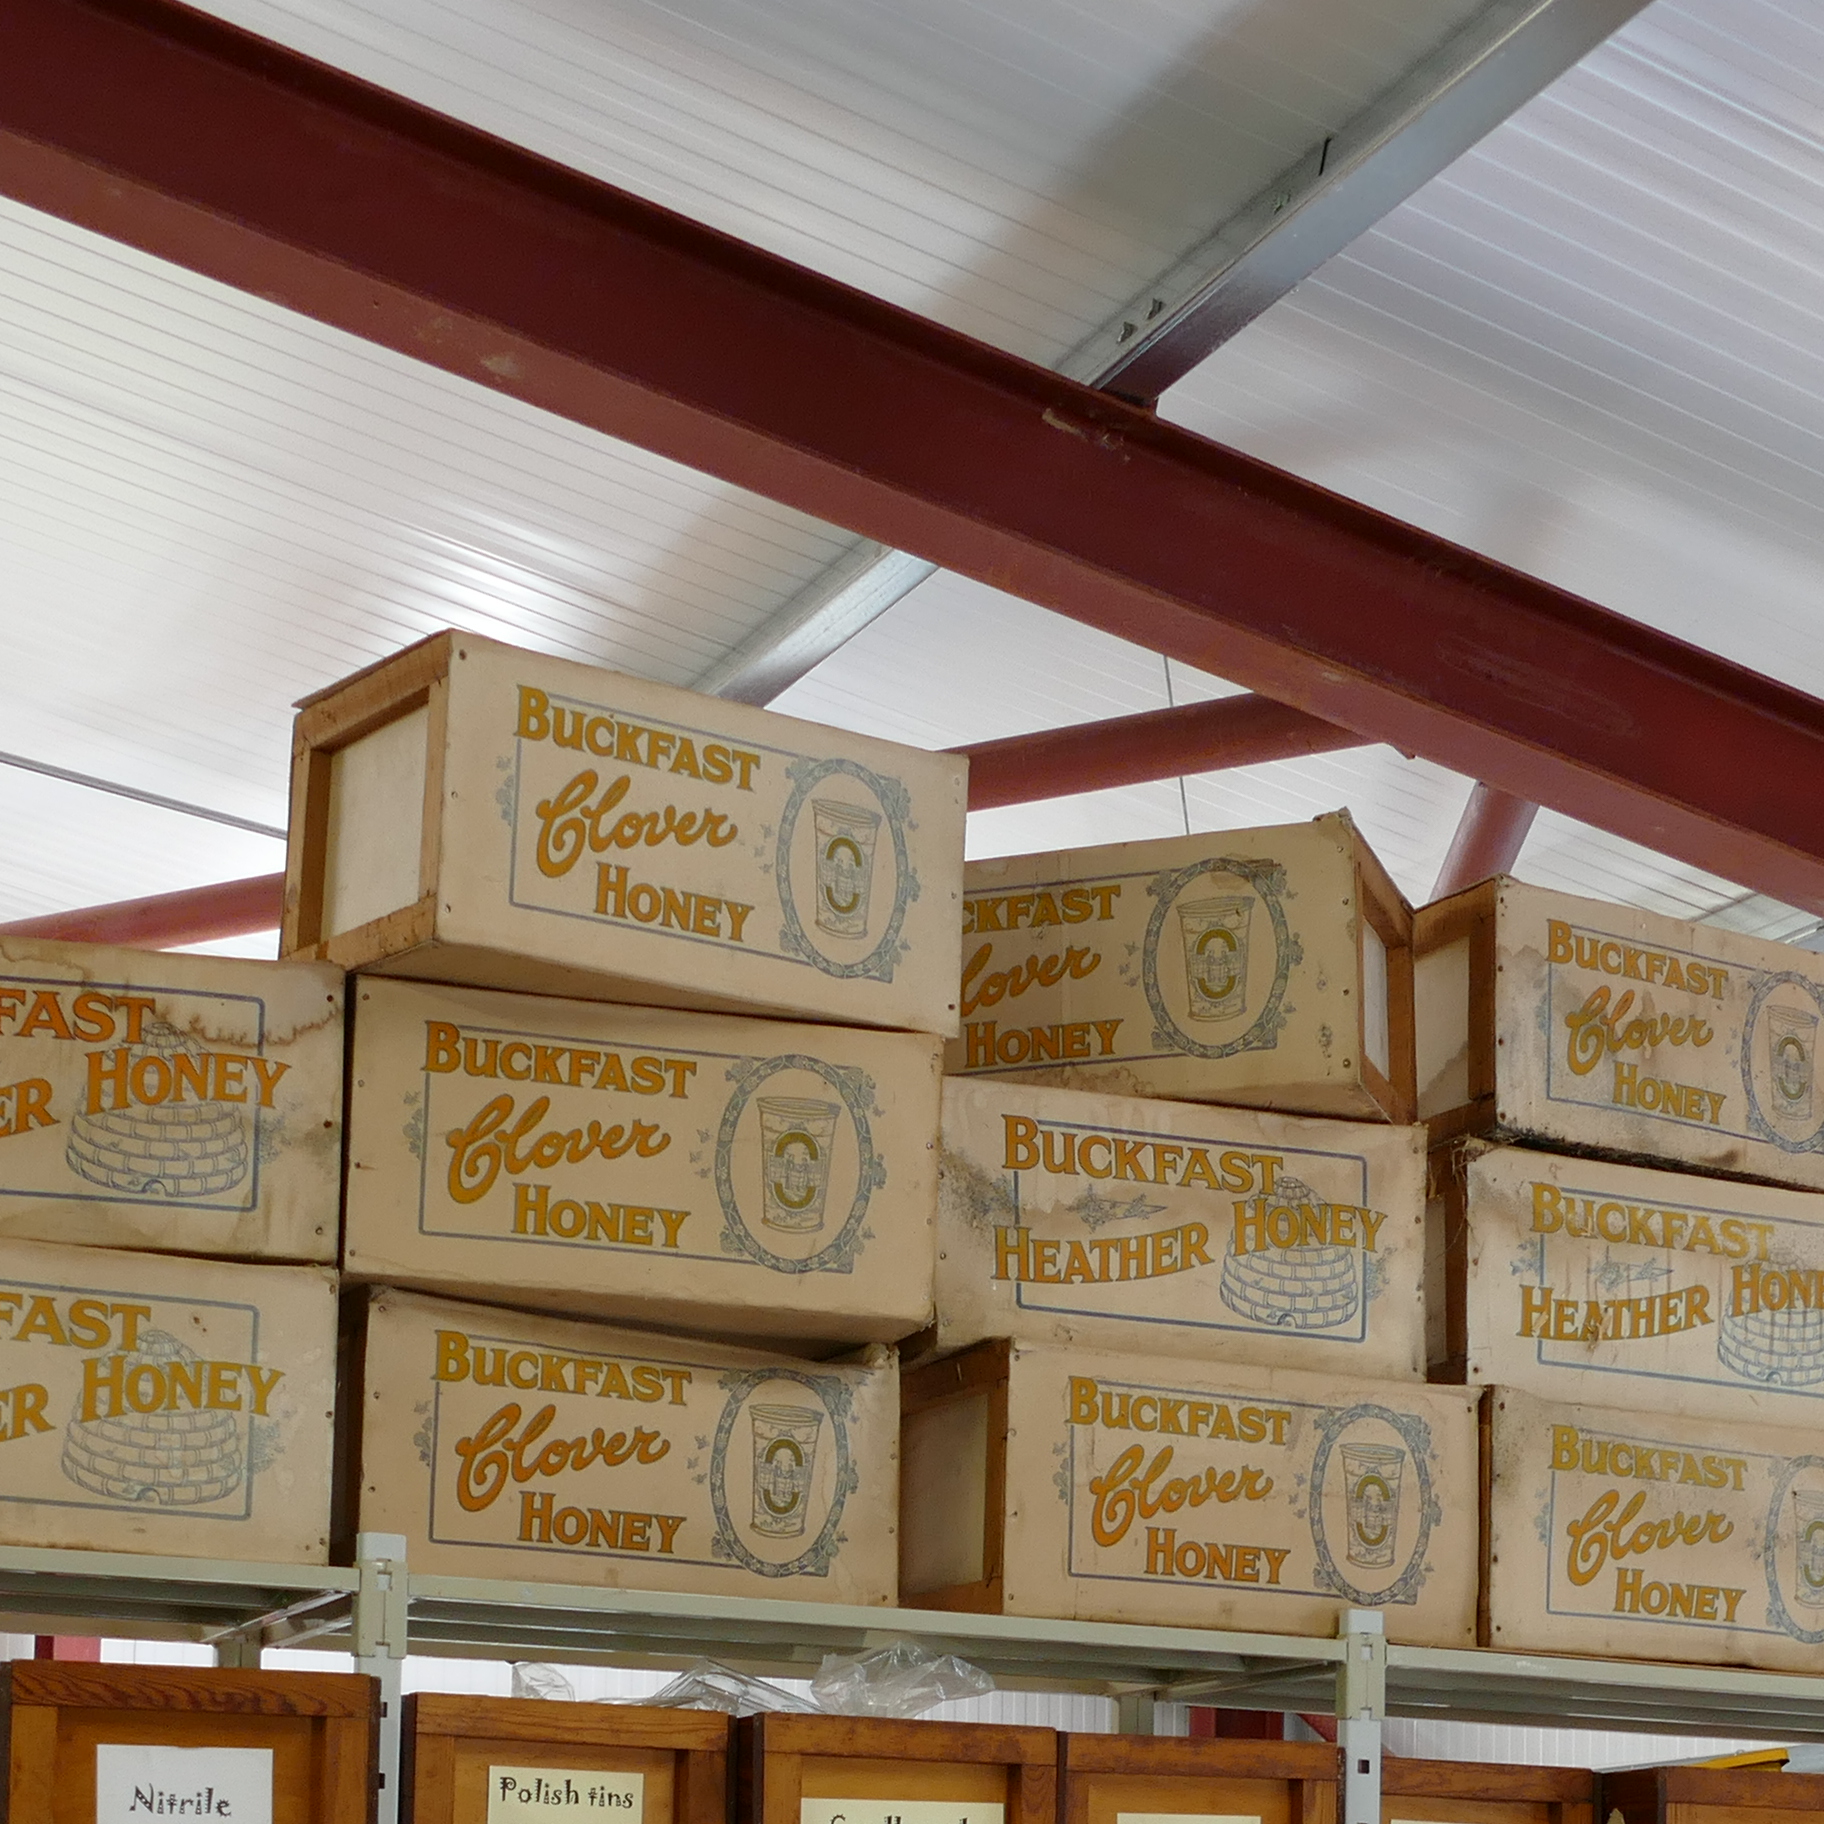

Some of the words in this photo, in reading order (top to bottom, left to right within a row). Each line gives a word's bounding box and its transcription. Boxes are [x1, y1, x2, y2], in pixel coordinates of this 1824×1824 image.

[514, 684, 761, 793] BUCKFAST
[535, 768, 738, 878] Clover
[594, 862, 755, 942] HONEY
[961, 885, 1122, 934] CKFAST
[960, 943, 1101, 1017] lover
[1546, 919, 1729, 1001] BUCKFAST
[422, 1020, 697, 1099] BUCKFAST
[965, 1018, 1124, 1069] HONEY
[1565, 984, 1713, 1076] Clover
[84, 1049, 291, 1115] HONEY
[1612, 1062, 1727, 1126] HONEY
[446, 1094, 671, 1204] Clover
[1001, 1115, 1283, 1197] BUCKFAST
[512, 1184, 691, 1248] HONEY
[992, 1221, 1214, 1284] HEATHER
[1231, 1199, 1388, 1258] HONEY
[1529, 1182, 1774, 1263] BUCKFAST
[1516, 1284, 1714, 1342] HEATHER
[80, 1357, 285, 1423] HONEY
[433, 1329, 692, 1406] BUCKFAST
[1067, 1376, 1292, 1446] BUCKFAST
[456, 1403, 670, 1512] Clover
[1548, 1424, 1748, 1490] BUCKFAST
[518, 1491, 686, 1554] HONEY
[1090, 1443, 1274, 1547] Clover
[1144, 1527, 1291, 1585] HONEY
[1566, 1490, 1734, 1586] Clover
[1614, 1568, 1746, 1622] HONEY
[130, 1783, 232, 1818] Nitrile
[499, 1776, 579, 1805] Polish
[588, 1787, 634, 1809] tins
